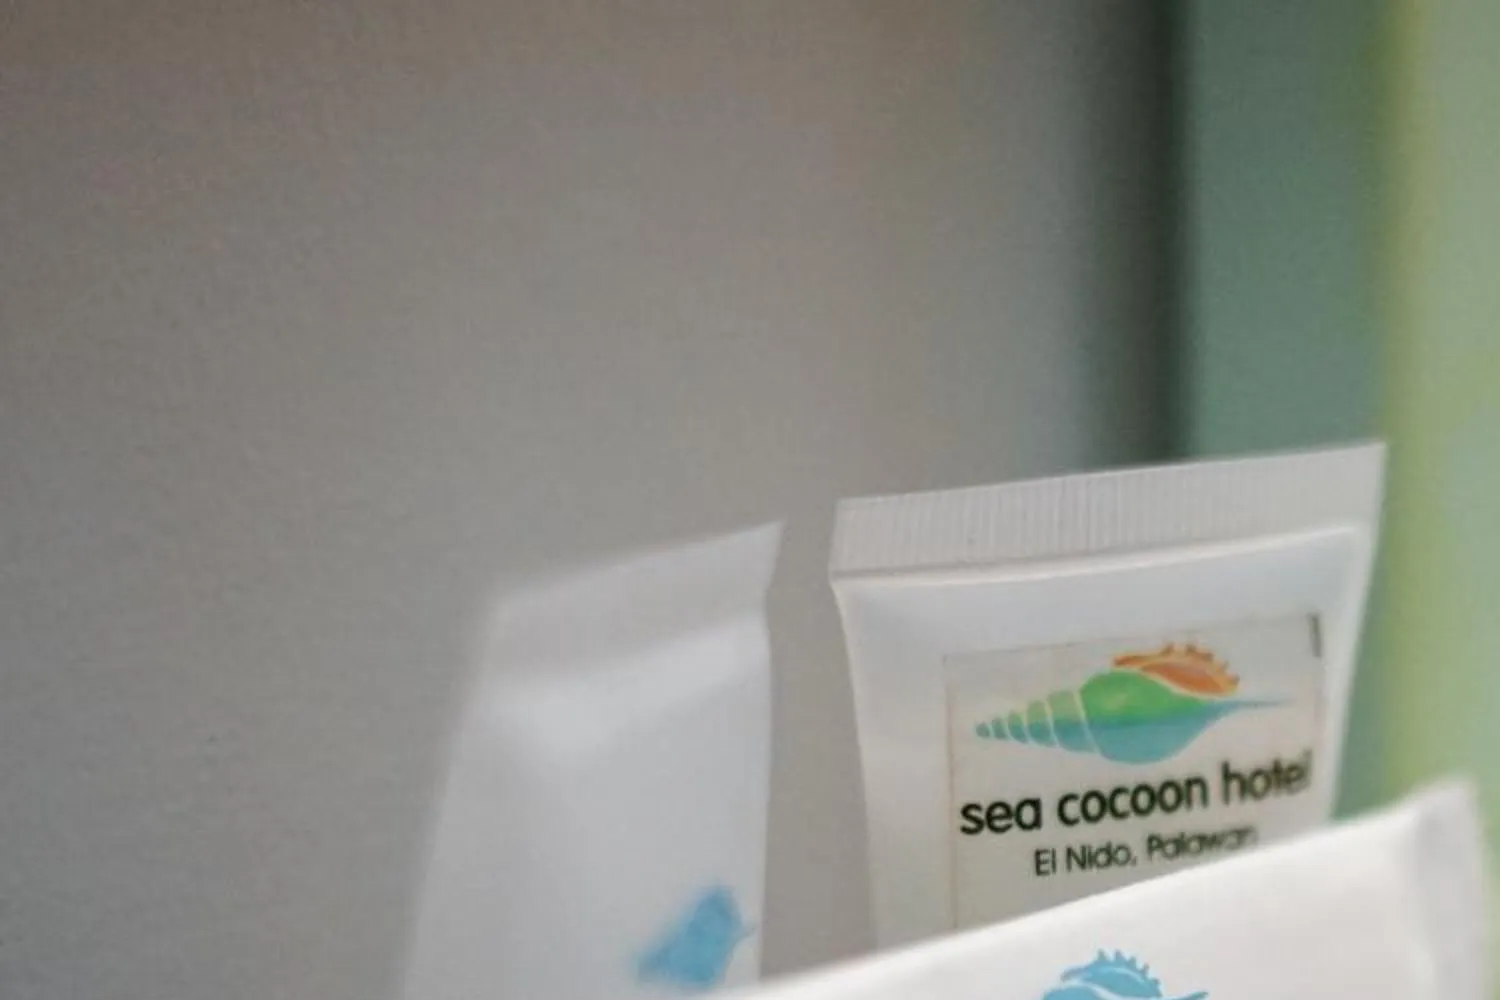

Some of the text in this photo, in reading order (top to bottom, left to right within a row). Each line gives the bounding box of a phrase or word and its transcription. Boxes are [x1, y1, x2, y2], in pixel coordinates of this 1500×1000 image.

[960, 749, 1313, 836] sea cocoon hotel
[1034, 826, 1258, 877] El Nido, Palawan
